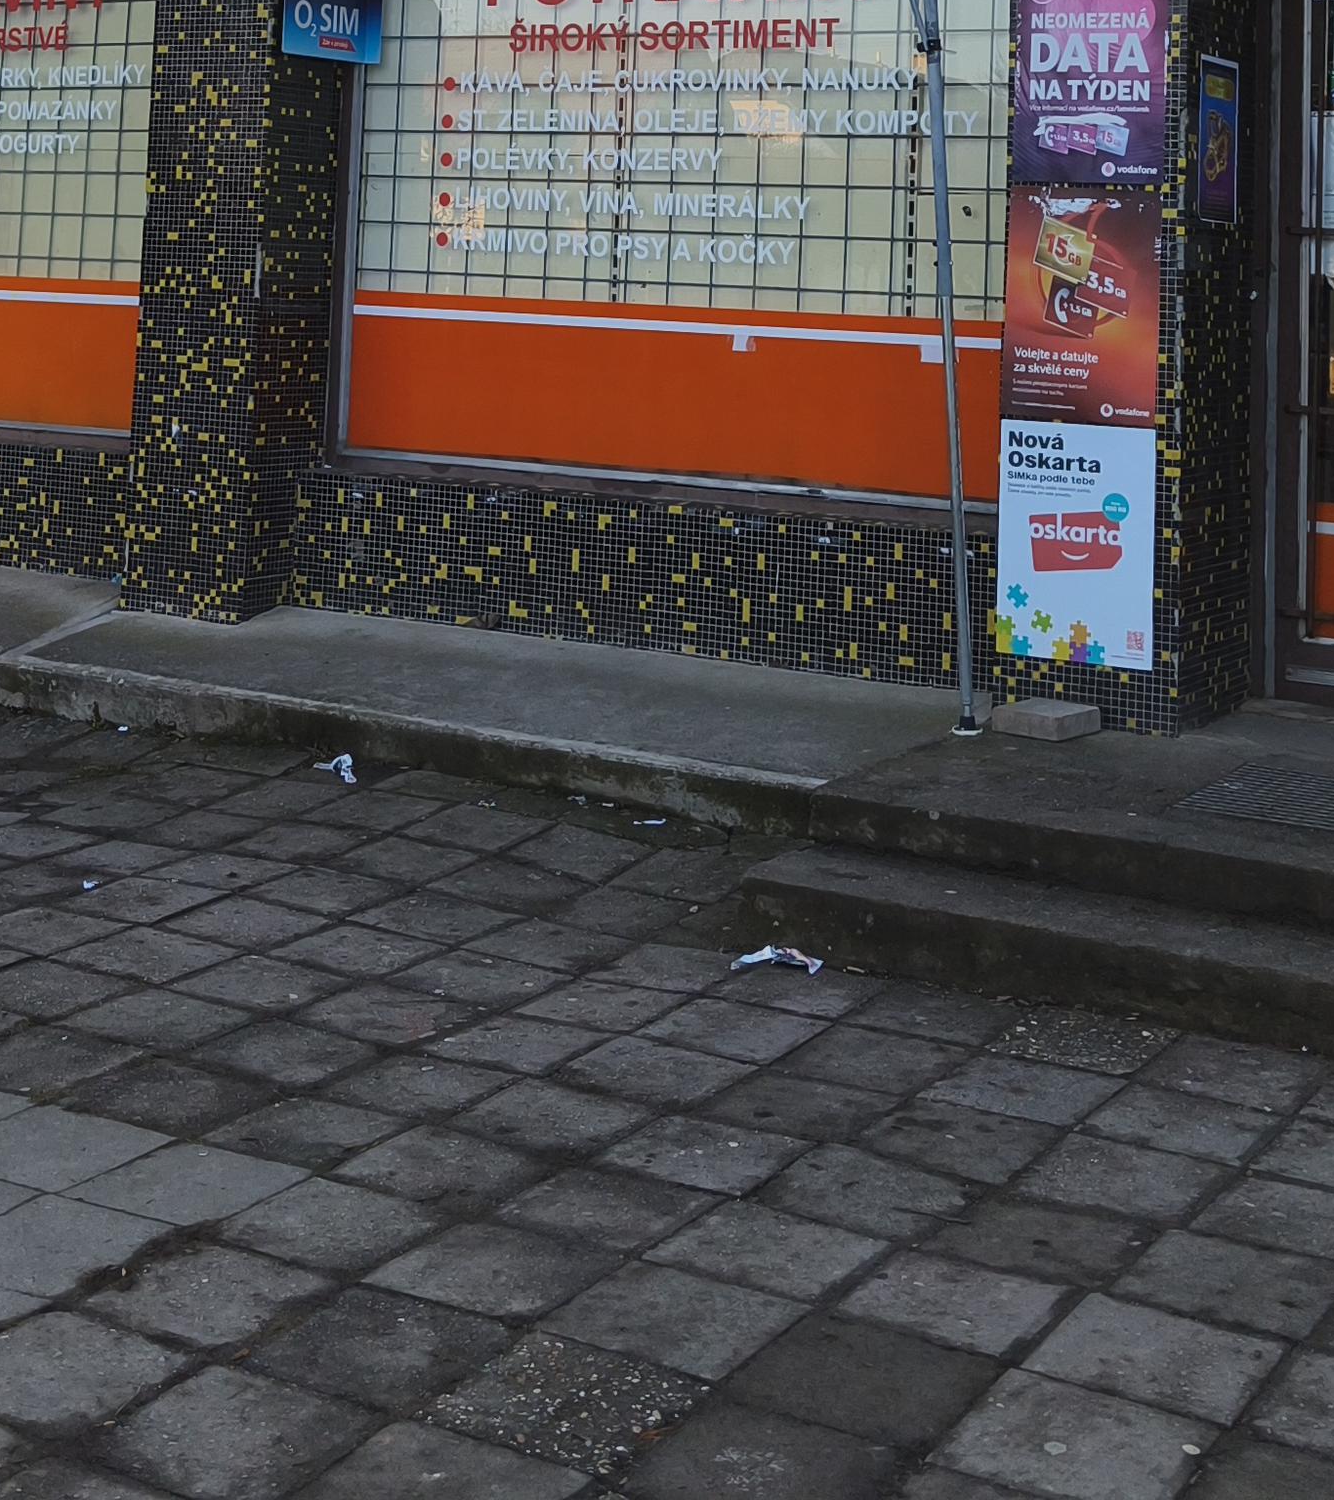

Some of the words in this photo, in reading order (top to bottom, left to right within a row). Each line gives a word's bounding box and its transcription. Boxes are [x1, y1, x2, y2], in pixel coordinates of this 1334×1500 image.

[320, 3, 360, 37] SIM
[1031, 7, 1150, 29] NEOMEZENÁ
[509, 14, 629, 53] ŠIROKÝ
[639, 17, 841, 52] SORTIMENT
[1030, 33, 1150, 73] DATA
[48, 60, 146, 87] KNEDLÍKY
[460, 67, 530, 97] KÁVA,
[539, 66, 609, 96] ČAJE,
[615, 67, 792, 95] CUKROVINKY,
[802, 67, 918, 92] NANUKY
[1029, 79, 1063, 100] NA
[1067, 73, 1150, 101] TÝDEN
[635, 109, 725, 136] OLEJE,
[457, 143, 574, 175] POLÉVKY,
[583, 147, 723, 172] KONZERVY
[1117, 165, 1158, 175] vodafone
[579, 186, 644, 219] VÍNA,
[654, 190, 811, 220] MINERÁLKY
[451, 230, 547, 254] KRMIVO
[556, 232, 608, 258] PRO
[617, 233, 669, 260] PSY
[672, 237, 692, 262] A
[698, 234, 795, 265] KOČKY
[1045, 232, 1068, 259] 15
[1068, 254, 1082, 267] GB
[1087, 270, 1115, 295] 3,5
[1115, 287, 1127, 299] GB
[1014, 346, 1050, 361] Volejte
[1052, 352, 1058, 360] a
[1061, 350, 1099, 364] datujte
[1013, 364, 1026, 372] za
[1028, 363, 1061, 376] skvělé
[1063, 367, 1089, 379] ceny
[1008, 430, 1064, 450] Nová
[1008, 450, 1101, 473] Oskarta
[1007, 470, 1038, 481] SIMka
[1040, 473, 1068, 484] podle
[1072, 476, 1095, 486] tebe
